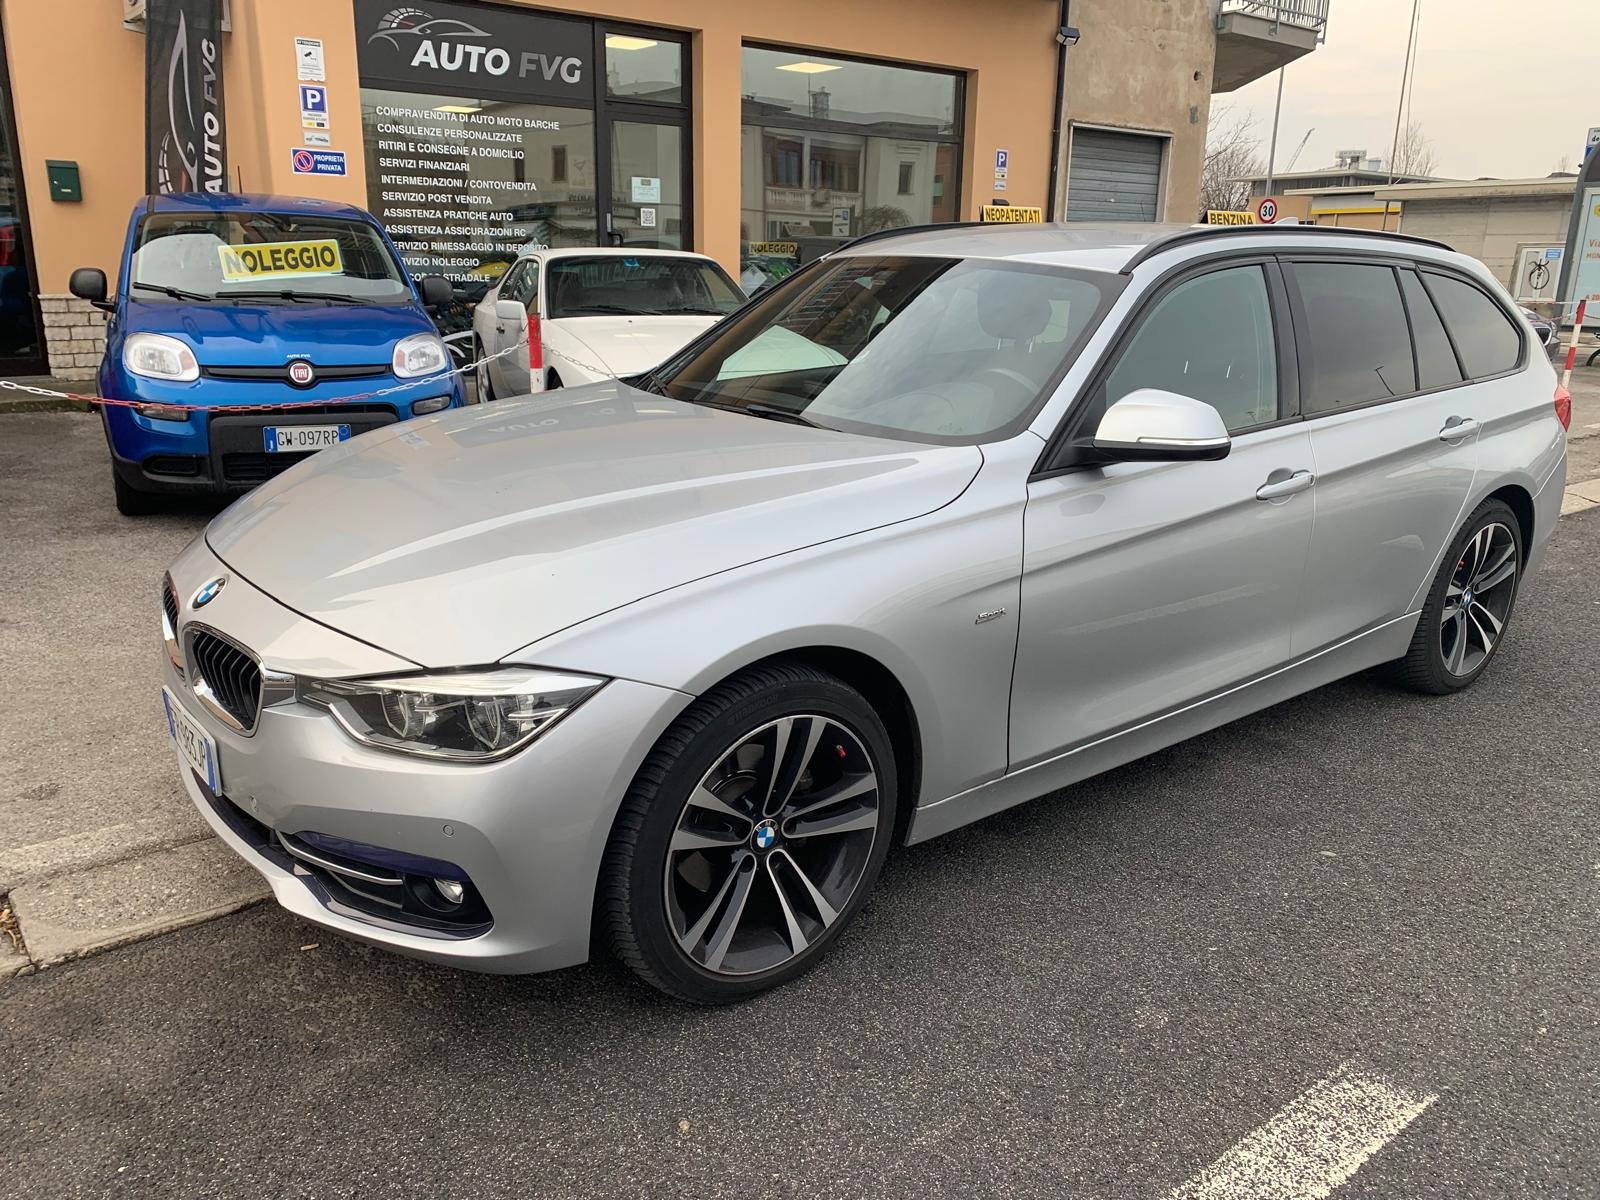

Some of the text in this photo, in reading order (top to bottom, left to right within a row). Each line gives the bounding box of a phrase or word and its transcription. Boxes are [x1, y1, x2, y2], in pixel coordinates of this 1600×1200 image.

[410, 39, 583, 84] AUTO FVG
[306, 89, 321, 109] P
[201, 38, 223, 193] AUTO FVG
[376, 106, 560, 130] COMPRAVENDITA DI AUTO MOTO BARCHE
[377, 123, 522, 143] CONSULENZE PERSONALIZZATE
[378, 140, 525, 160] RITIRI E CONSEGNE A DOMICILIO
[379, 157, 470, 171] SERVIZI FINANZIARI
[998, 152, 1006, 167] P
[317, 163, 342, 171] PRIVATA
[381, 174, 537, 191] INTERMEDIAZIONI / CONTOVENDITA
[382, 191, 493, 205] SERVIZIO POST VENDITA
[383, 208, 514, 221] ASSISTENZA PRATICHE AUTO
[985, 207, 1040, 223] NEOPATENTATI
[1262, 205, 1274, 217] 30
[1210, 213, 1253, 224] BENZINA
[384, 224, 526, 237] ASSISTENZA ASSICURAZIONI RC
[392, 241, 429, 250] ERVIZIO
[430, 241, 493, 251] RIMESSAGGIO
[495, 243, 504, 251] IN
[750, 244, 796, 254] NOLEGGIO
[222, 245, 336, 274] NOLEGGIO
[401, 257, 479, 267] RVIZIO NOLEGGIO
[443, 273, 490, 282] STRADALE
